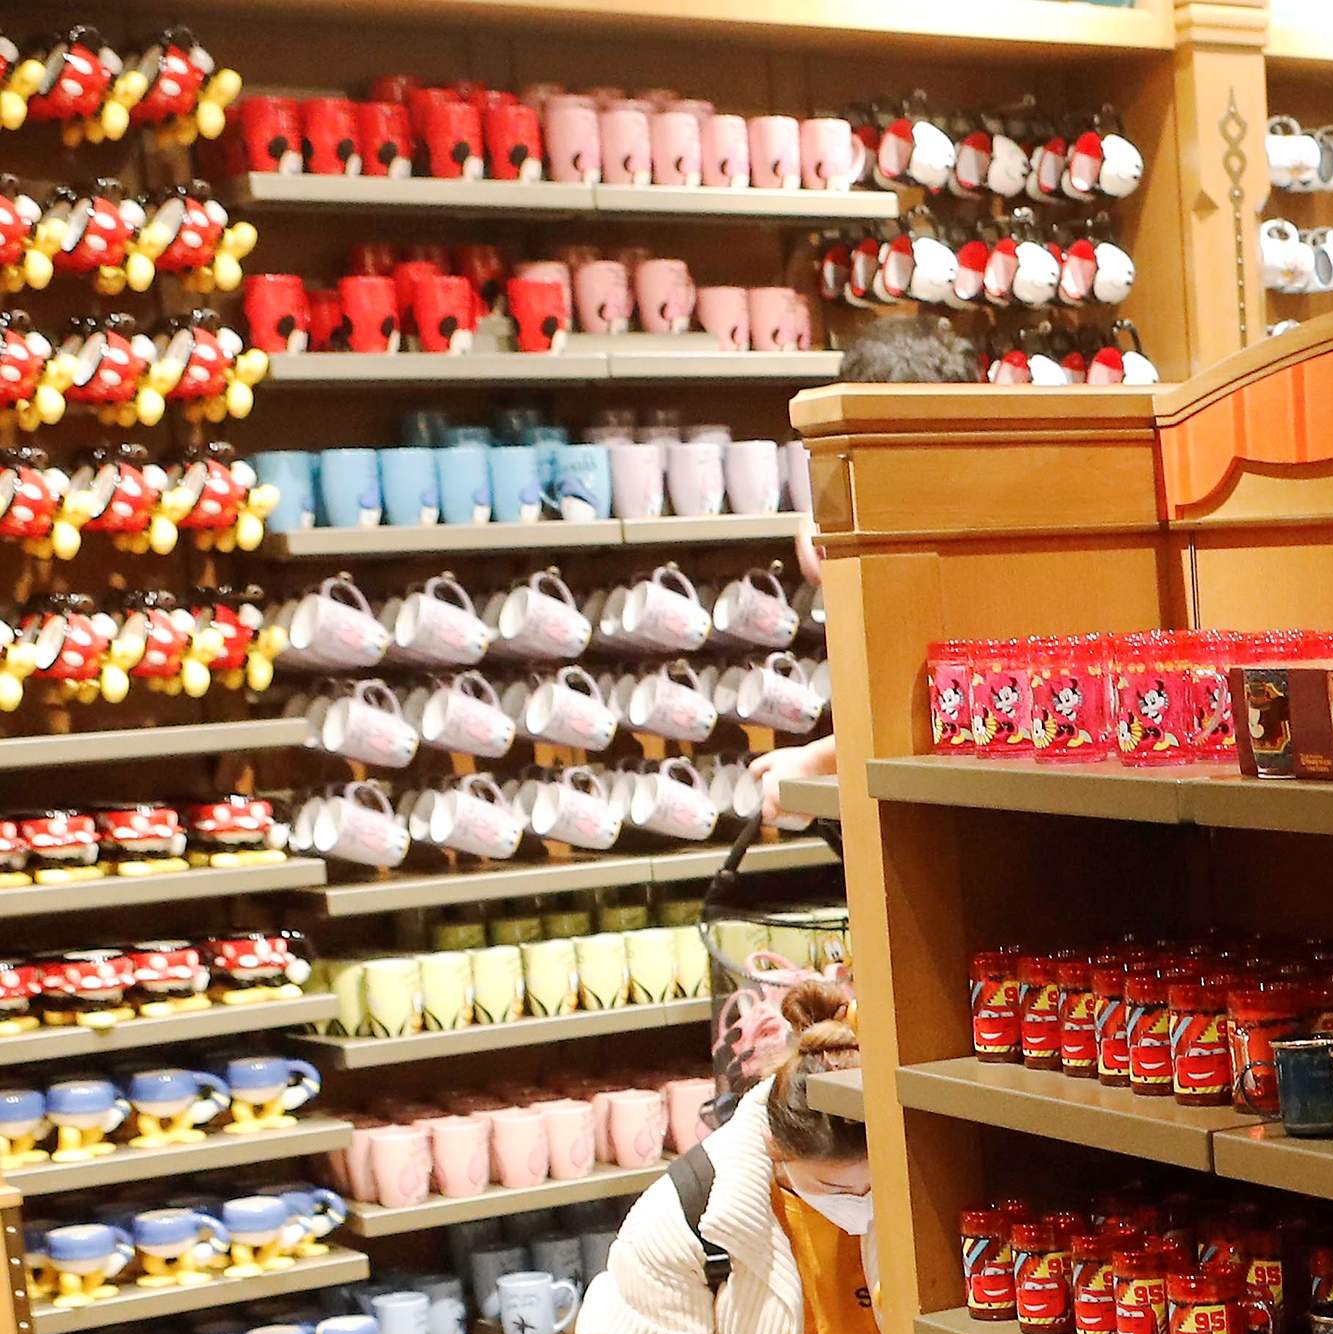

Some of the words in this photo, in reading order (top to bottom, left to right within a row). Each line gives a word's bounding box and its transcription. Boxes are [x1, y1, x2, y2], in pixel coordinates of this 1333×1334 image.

[1254, 1265, 1281, 1286] 95
[1133, 1284, 1164, 1306] 95
[1194, 1310, 1225, 1333] 95
